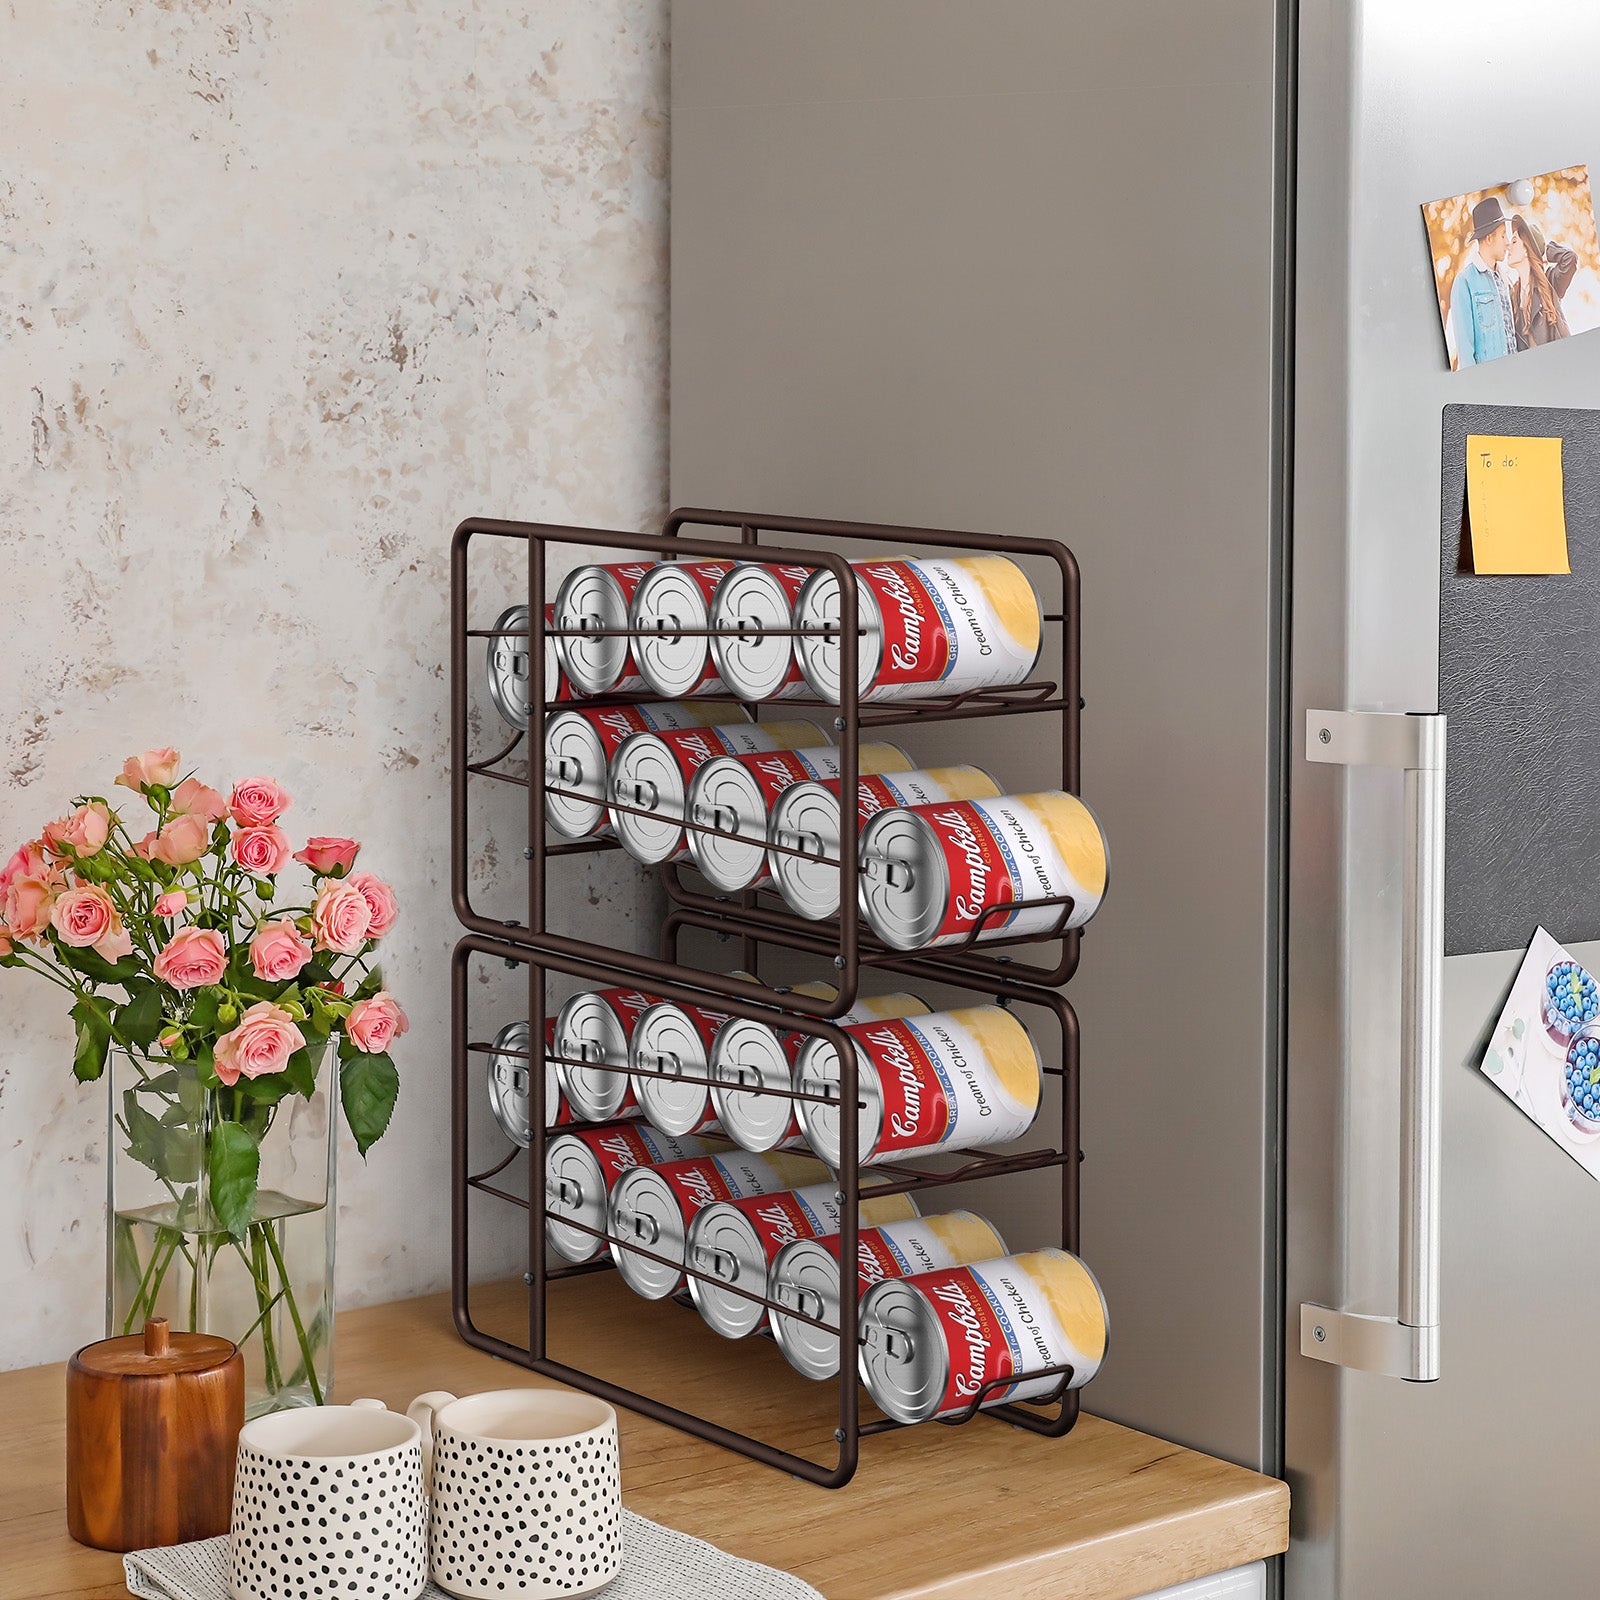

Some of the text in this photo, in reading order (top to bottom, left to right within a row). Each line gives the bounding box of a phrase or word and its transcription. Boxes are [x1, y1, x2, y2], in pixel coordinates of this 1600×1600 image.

[1480, 453, 1491, 468] To
[933, 566, 967, 606] Chicken
[914, 568, 958, 661] GREAT for COOKING
[961, 606, 975, 617] of
[968, 618, 992, 656] Cream
[803, 762, 821, 780] KING
[889, 786, 908, 807] KING
[970, 822, 992, 864] CONDENSED
[1000, 809, 1034, 852] Chicken
[981, 813, 1023, 901] REAT for COOKING
[1027, 854, 1041, 865] of
[902, 1039, 925, 1080] CONDENSED
[913, 1030, 958, 1124] GREAT for COOKING
[933, 1026, 992, 1117] Cream of Chicken
[721, 1170, 742, 1199] OKING
[756, 1204, 797, 1244] bell's
[803, 1207, 824, 1236] OKING
[889, 1244, 913, 1275] OKING
[970, 1295, 991, 1339] CONDENSED
[1000, 1278, 1034, 1324] Chicken
[981, 1283, 1022, 1373] REAT for COOKING
[1026, 1326, 1040, 1336] of
